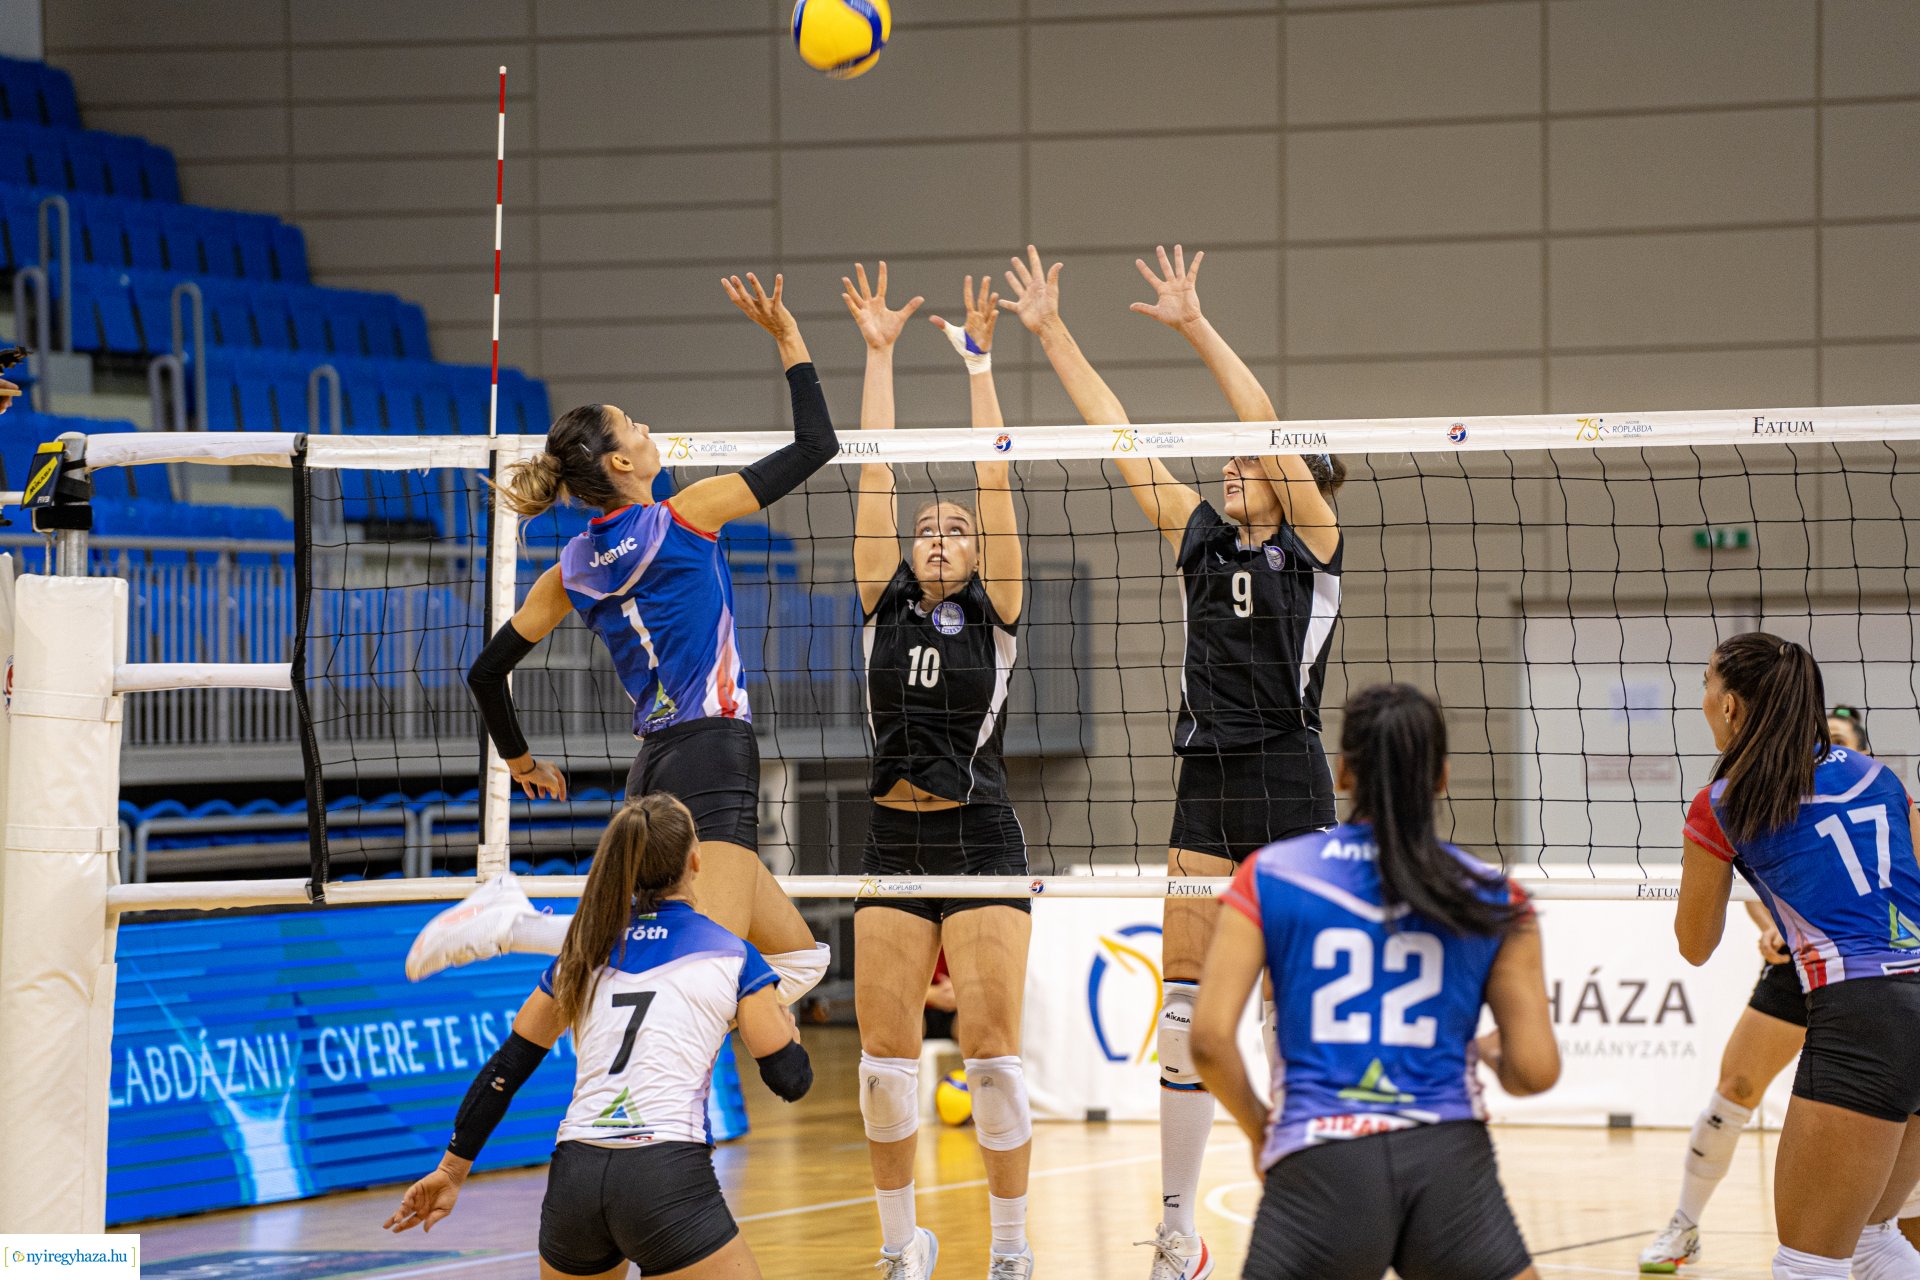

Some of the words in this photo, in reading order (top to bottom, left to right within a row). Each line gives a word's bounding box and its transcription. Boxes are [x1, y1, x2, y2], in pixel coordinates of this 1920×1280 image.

[1232, 571, 1254, 618] 9
[621, 597, 660, 670] 1
[908, 645, 941, 689] 10
[1815, 804, 1893, 897] 17
[1312, 928, 1444, 1048] 22
[319, 1019, 425, 1082] GYERE
[423, 1015, 468, 1070] TE
[471, 1011, 500, 1065] IS
[609, 991, 657, 1075] 7
